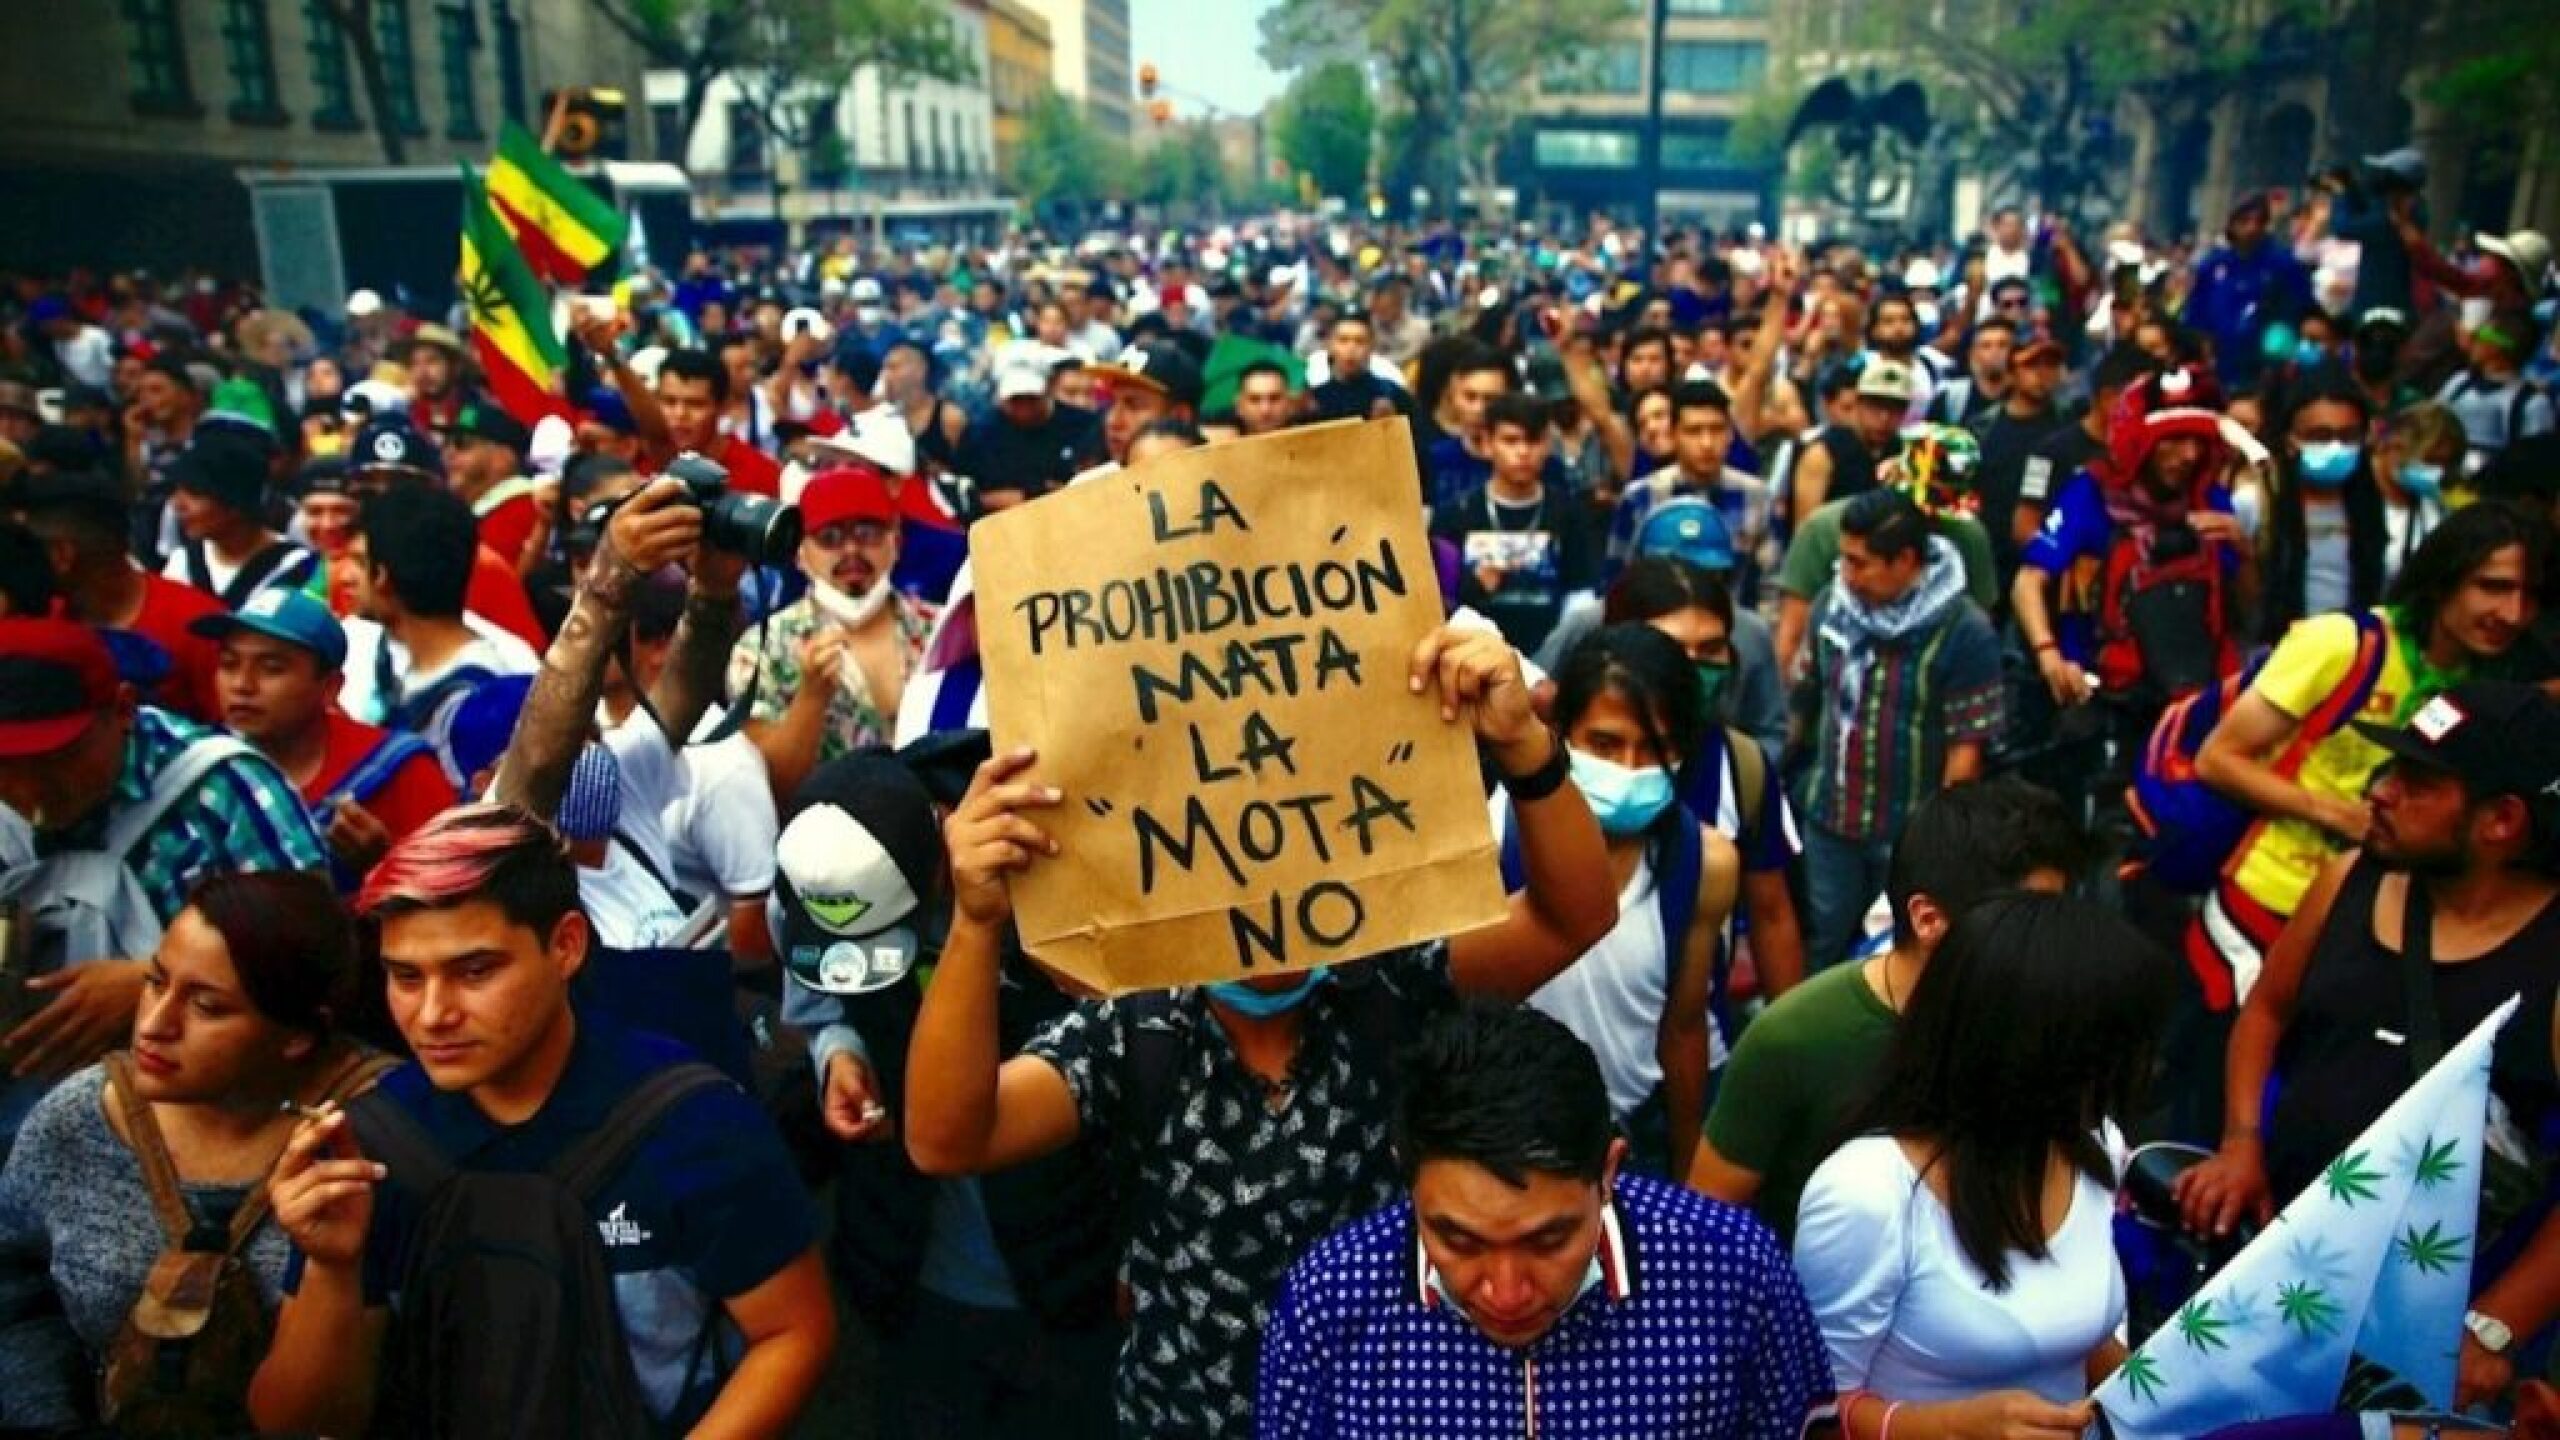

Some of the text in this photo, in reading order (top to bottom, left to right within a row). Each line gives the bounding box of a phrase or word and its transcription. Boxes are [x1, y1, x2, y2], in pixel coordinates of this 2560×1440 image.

[1149, 479, 1249, 544] LA
[1014, 526, 1406, 654] PROHIBICIÓN
[1132, 627, 1362, 726] MATA
[1188, 711, 1296, 785] LA
[1229, 881, 1365, 969] NO
